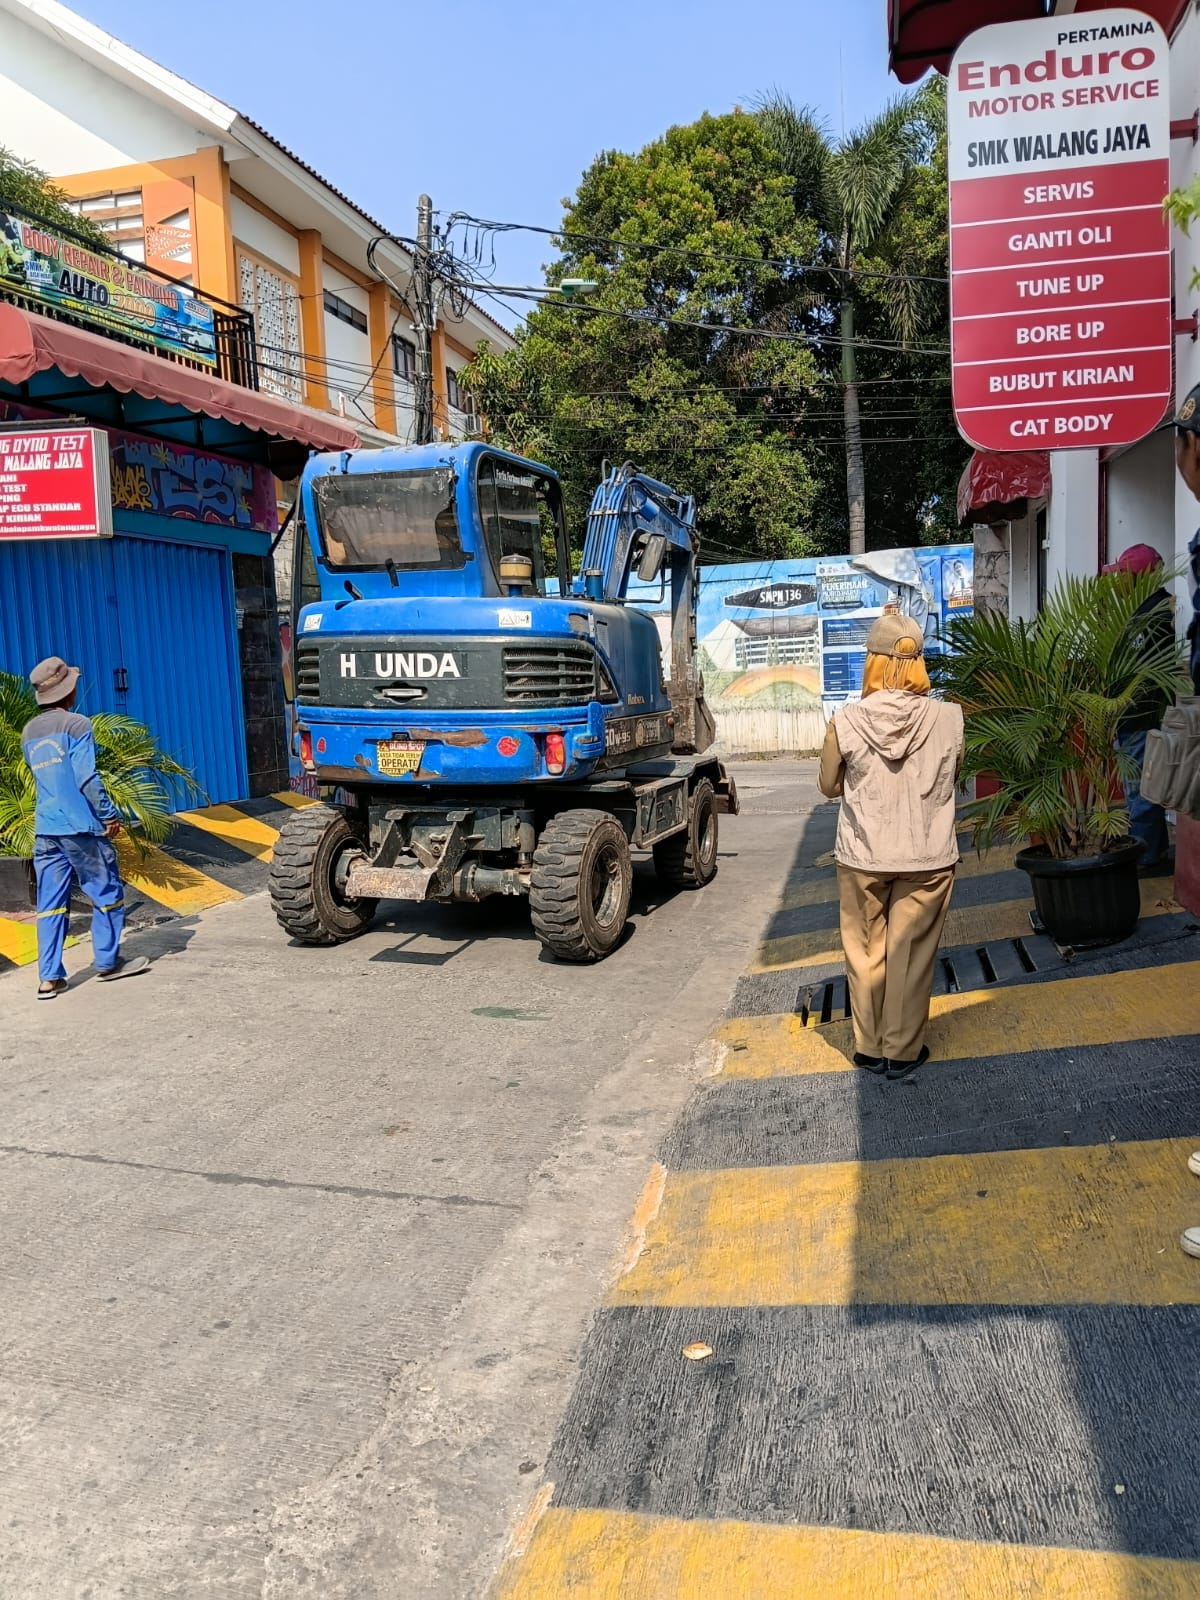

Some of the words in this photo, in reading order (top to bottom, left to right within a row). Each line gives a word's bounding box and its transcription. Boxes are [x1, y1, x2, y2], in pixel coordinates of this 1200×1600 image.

[1057, 21, 1155, 46] PERTAMINA
[957, 47, 1156, 92] Enduro
[968, 92, 1055, 118] MOTOR
[1062, 79, 1159, 108] SERVICE
[967, 139, 1009, 168] SMK
[1013, 129, 1099, 163] WALANG
[1103, 123, 1151, 154] JAYA
[1023, 180, 1095, 204] SERVIS
[1008, 230, 1072, 252] GANTI
[1078, 226, 1112, 245] OLI
[21, 224, 60, 260] BODY
[62, 242, 110, 283] REPAIR
[111, 264, 125, 287] &
[126, 270, 180, 312] PAINTING
[58, 267, 109, 308] AUTO
[112, 288, 156, 328] 2000
[1016, 276, 1071, 298] TUNE
[1076, 273, 1105, 292] UP
[1016, 325, 1071, 345] BORE
[1077, 321, 1105, 339] UP
[989, 371, 1057, 393] BUBUT
[1062, 365, 1134, 387] KIRIAN
[1009, 418, 1049, 437] CAT
[1054, 413, 1113, 434] BODY
[12, 437, 49, 454] DYNO
[52, 435, 88, 451] TEST
[3, 453, 51, 472] WALANG
[54, 452, 83, 469] JAYA
[2, 483, 27, 493] TEST
[6, 513, 41, 523] KIRIAN
[11, 504, 31, 512] ECU
[33, 503, 81, 512] STANDAR
[760, 590, 783, 603] SMPN
[785, 589, 802, 601] 136
[340, 653, 356, 677] H
[375, 653, 460, 677] UNDA
[408, 743, 424, 751] SPOT
